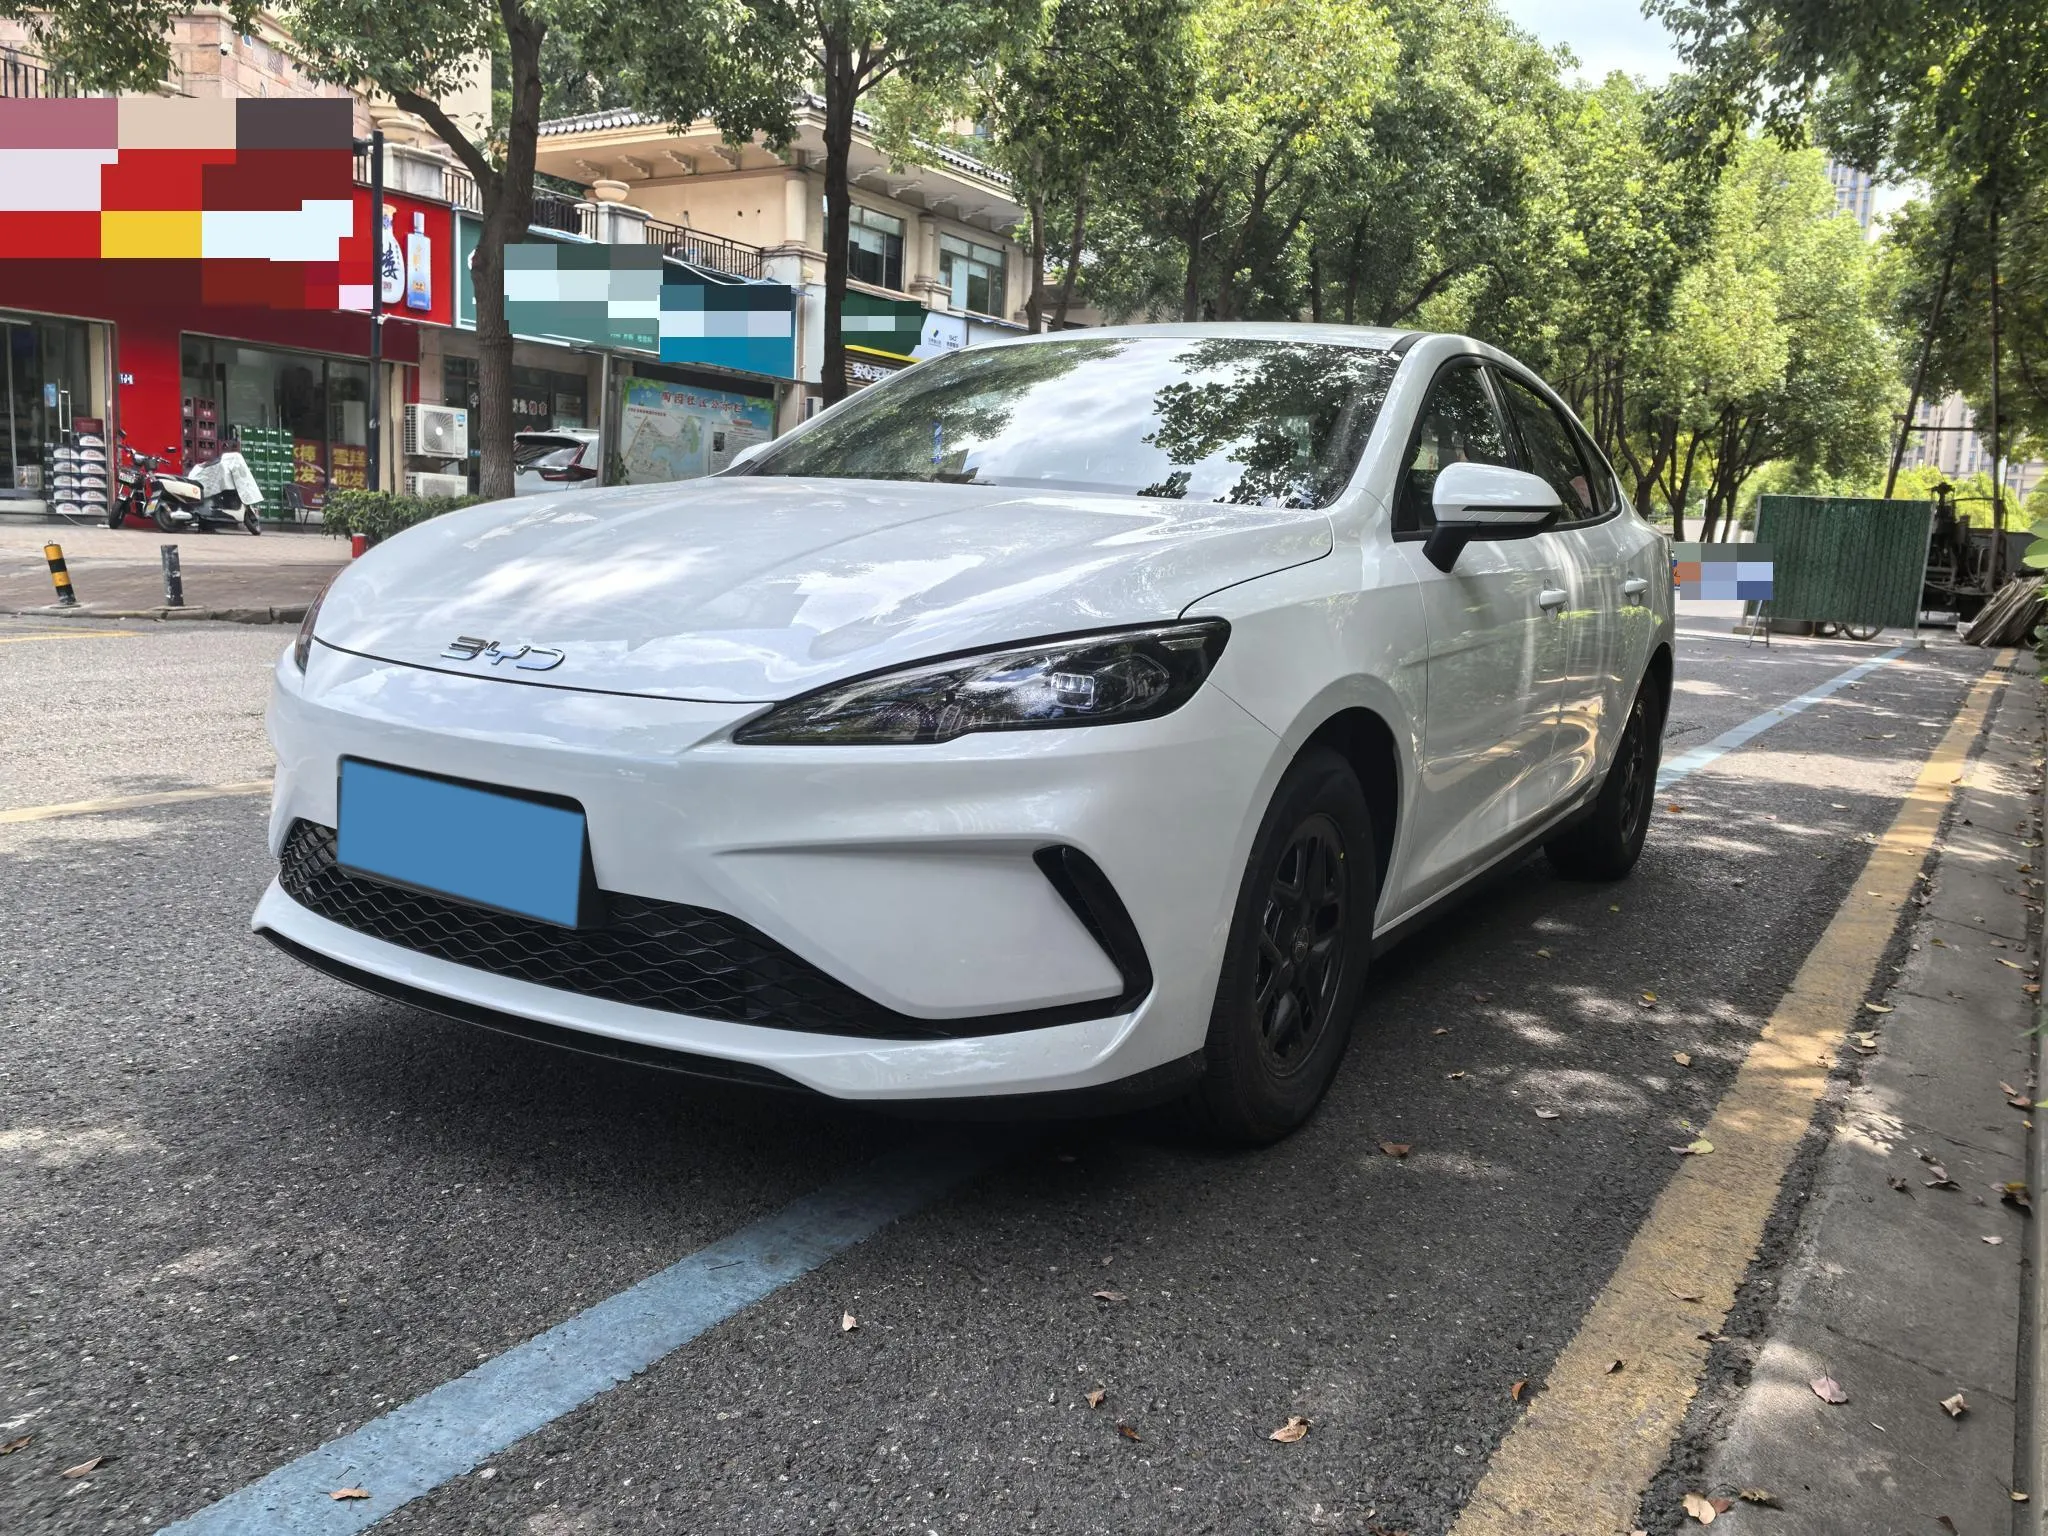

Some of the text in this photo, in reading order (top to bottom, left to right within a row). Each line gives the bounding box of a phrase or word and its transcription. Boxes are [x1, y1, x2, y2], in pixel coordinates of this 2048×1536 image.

[333, 447, 366, 467] 雪糕
[334, 468, 366, 489] 批发
[440, 635, 566, 671] BYD
